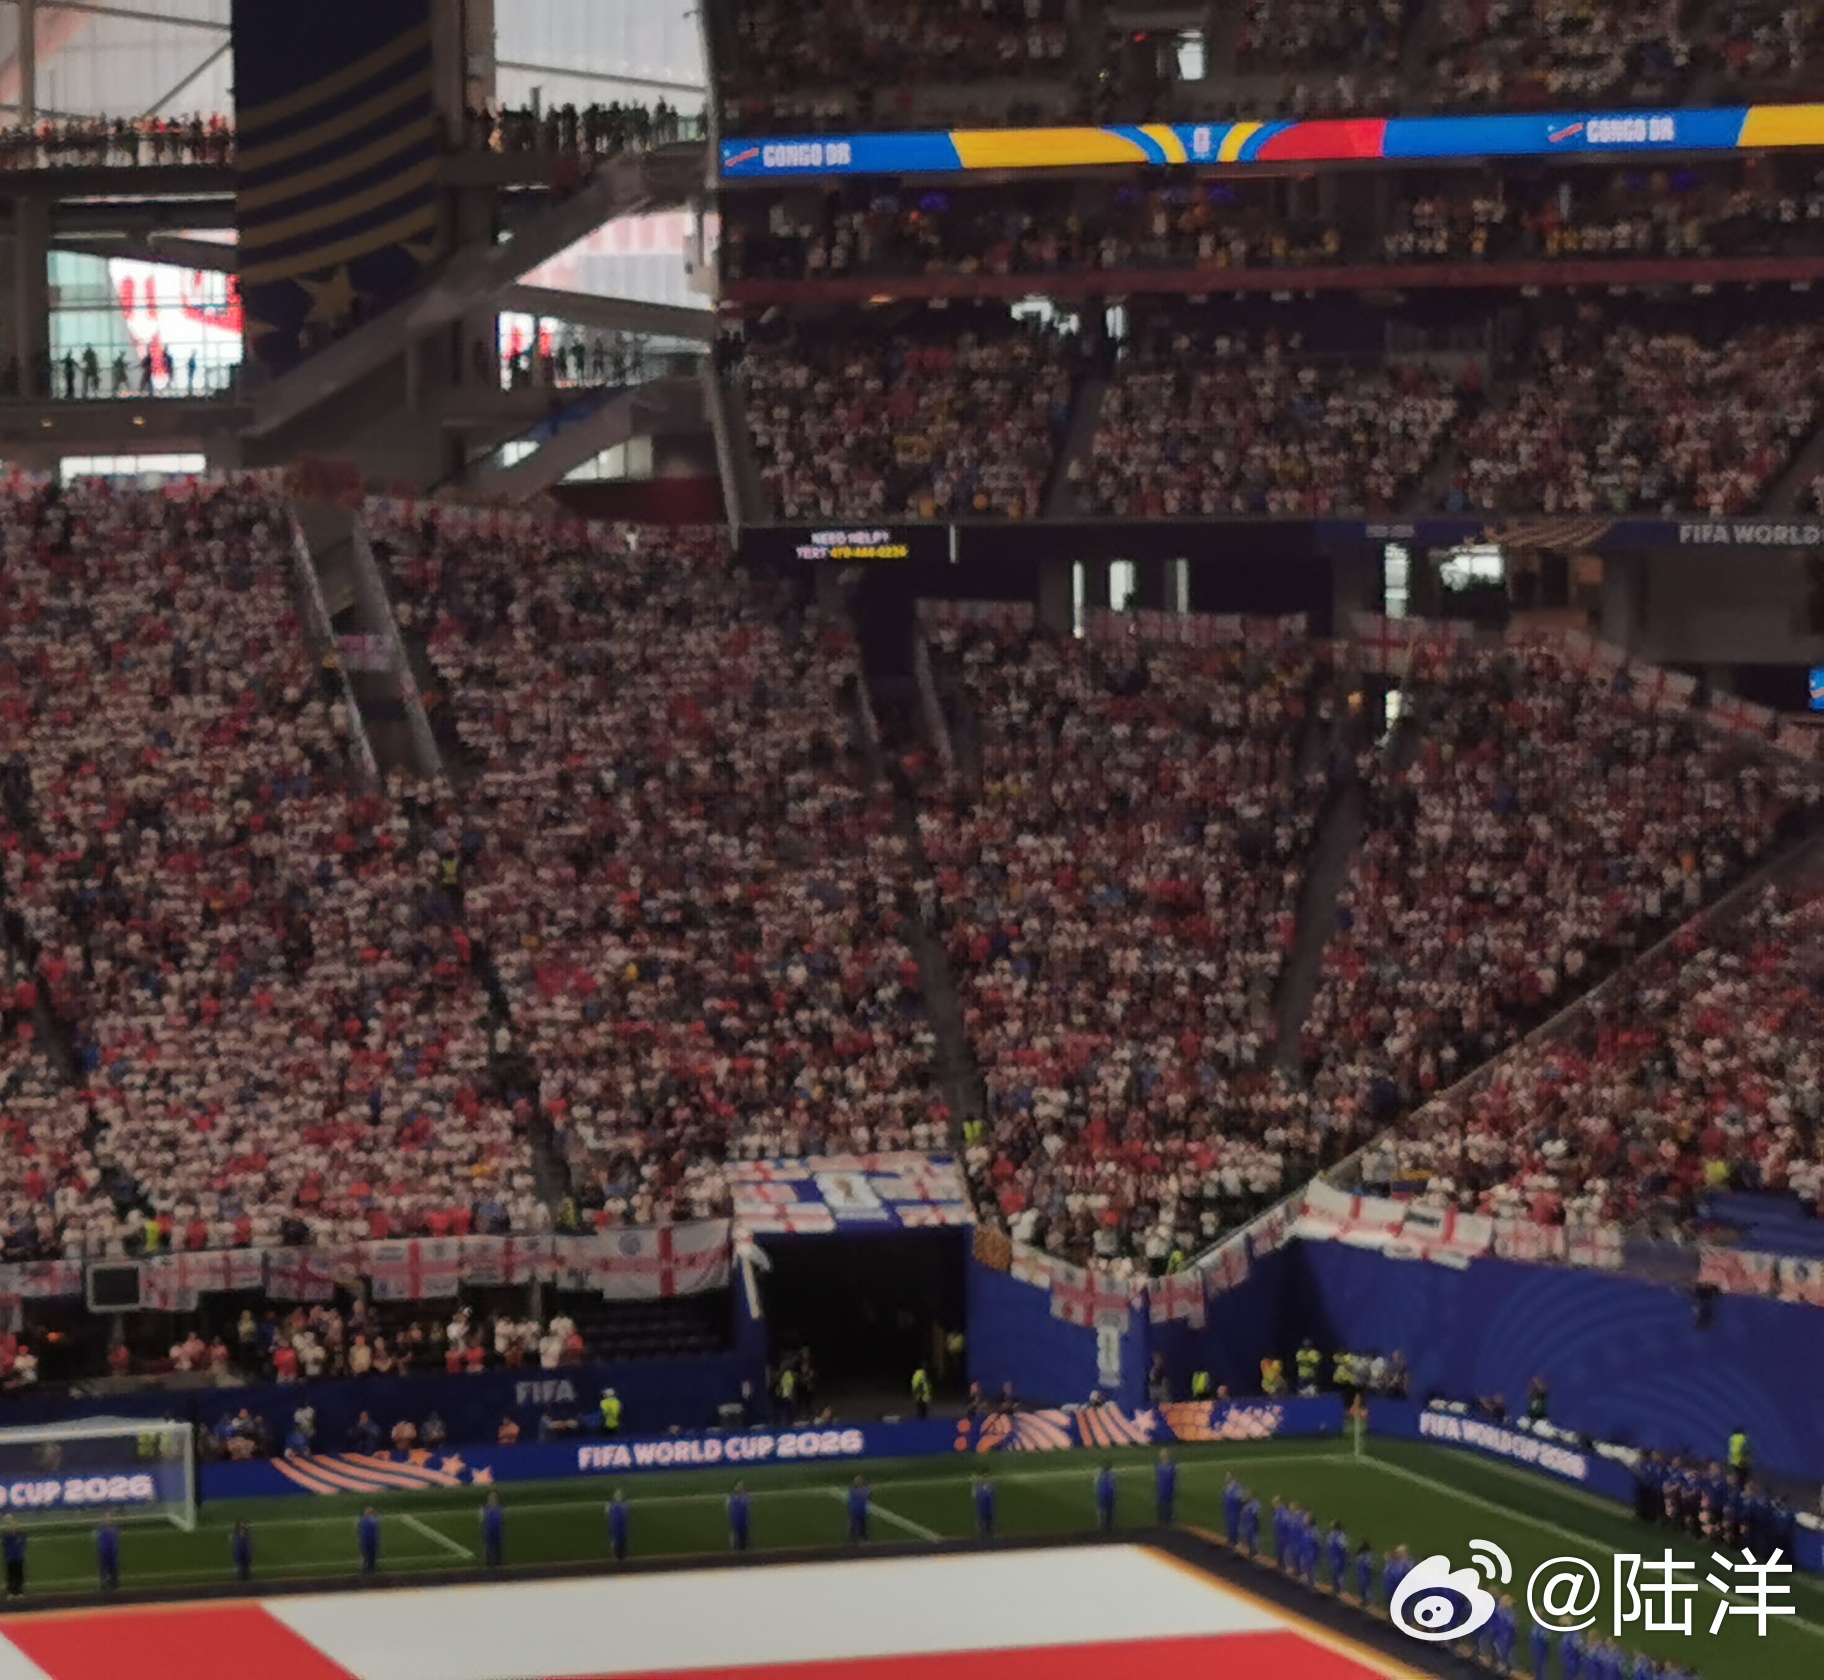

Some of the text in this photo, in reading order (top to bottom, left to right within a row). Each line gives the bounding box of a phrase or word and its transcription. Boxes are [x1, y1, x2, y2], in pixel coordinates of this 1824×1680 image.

[1587, 117, 1674, 142] CONGO DR
[763, 142, 852, 167] CONGO DR
[1679, 524, 1820, 545] FIFA WORLD
[516, 1380, 575, 1404] FIFA
[1419, 1412, 1463, 1442] FIFA
[578, 1429, 864, 1471] FIFA WORLD CUP 2026
[10, 1480, 61, 1506] CUP
[64, 1474, 154, 1502] 2026
